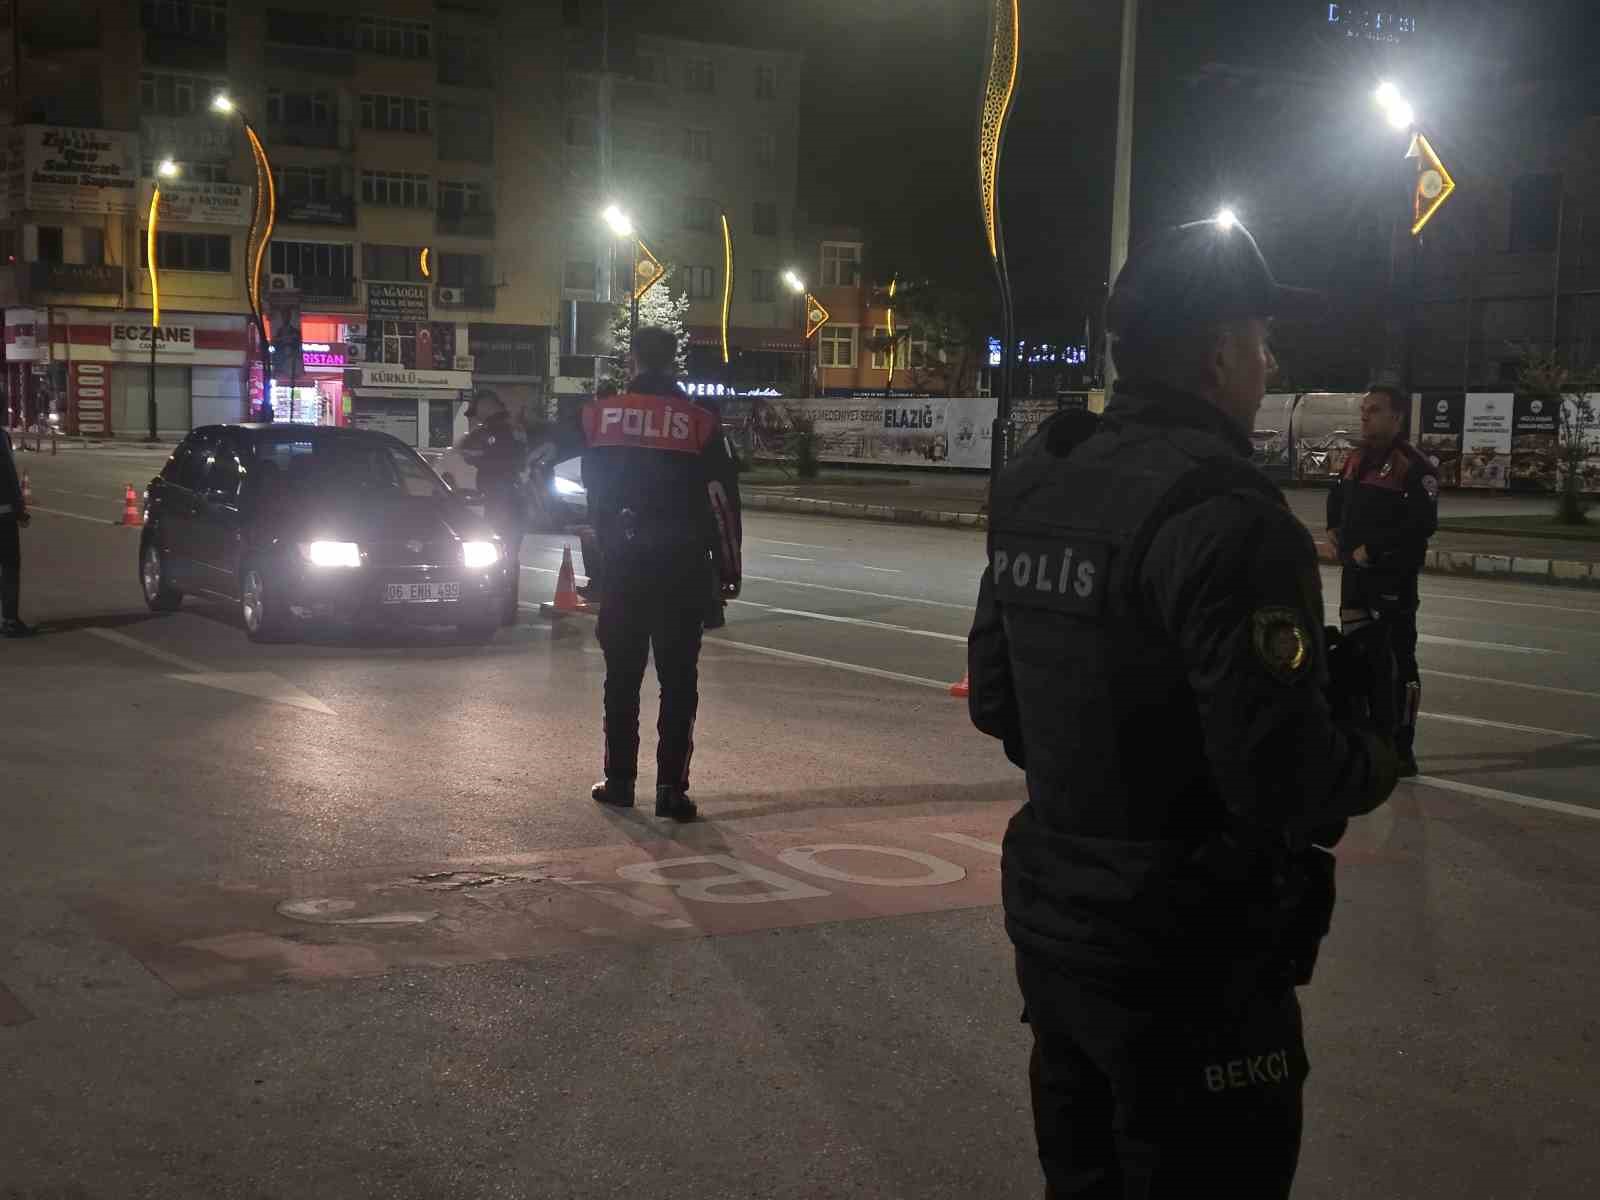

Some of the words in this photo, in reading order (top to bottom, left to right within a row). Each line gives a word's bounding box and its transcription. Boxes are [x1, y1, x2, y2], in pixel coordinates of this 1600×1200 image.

[114, 325, 191, 343] ECZANE
[600, 405, 689, 439] POLİS
[884, 404, 933, 429] ELAZIĞ
[992, 547, 1096, 597] POLİS
